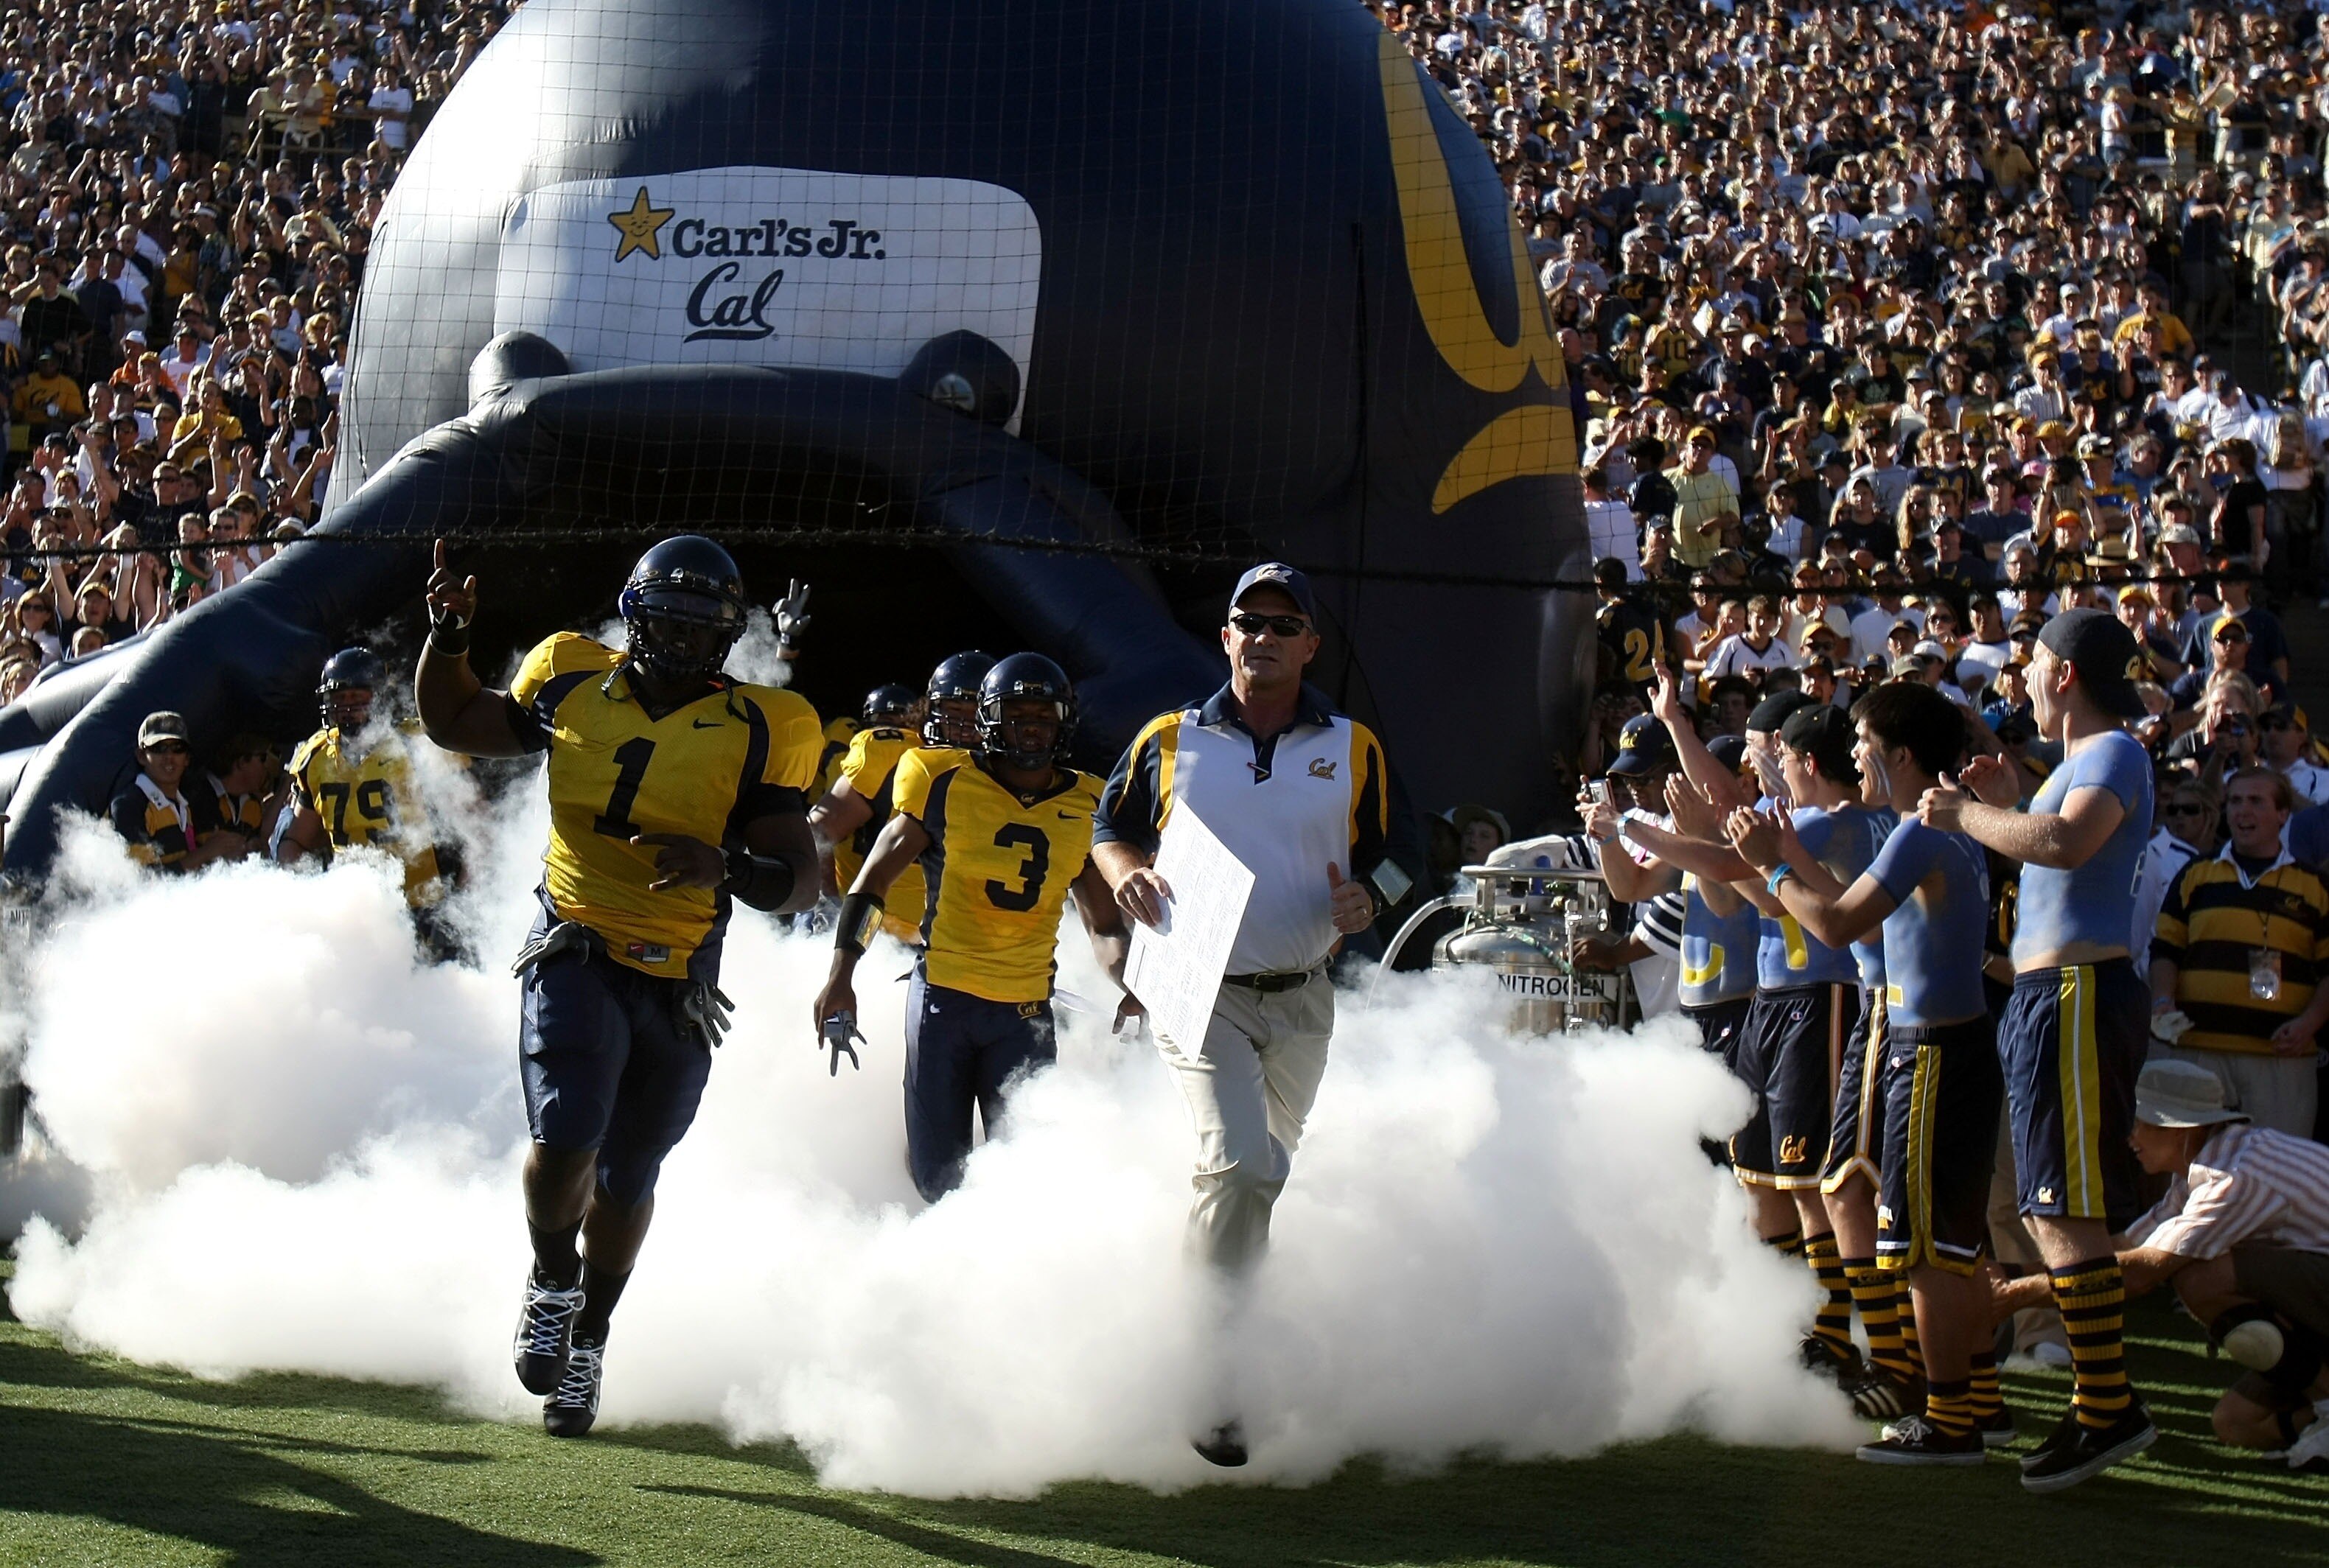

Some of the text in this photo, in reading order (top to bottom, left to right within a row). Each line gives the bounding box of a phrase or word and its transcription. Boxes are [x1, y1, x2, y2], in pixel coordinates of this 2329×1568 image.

[672, 218, 886, 259] Carl's Jr.
[683, 261, 784, 343] Cal
[1253, 564, 1293, 583] Cal
[593, 737, 656, 841] 1
[1307, 757, 1337, 781] Cal
[320, 779, 399, 846] 79
[985, 822, 1050, 911] 3
[1780, 1135, 1806, 1164] Cal
